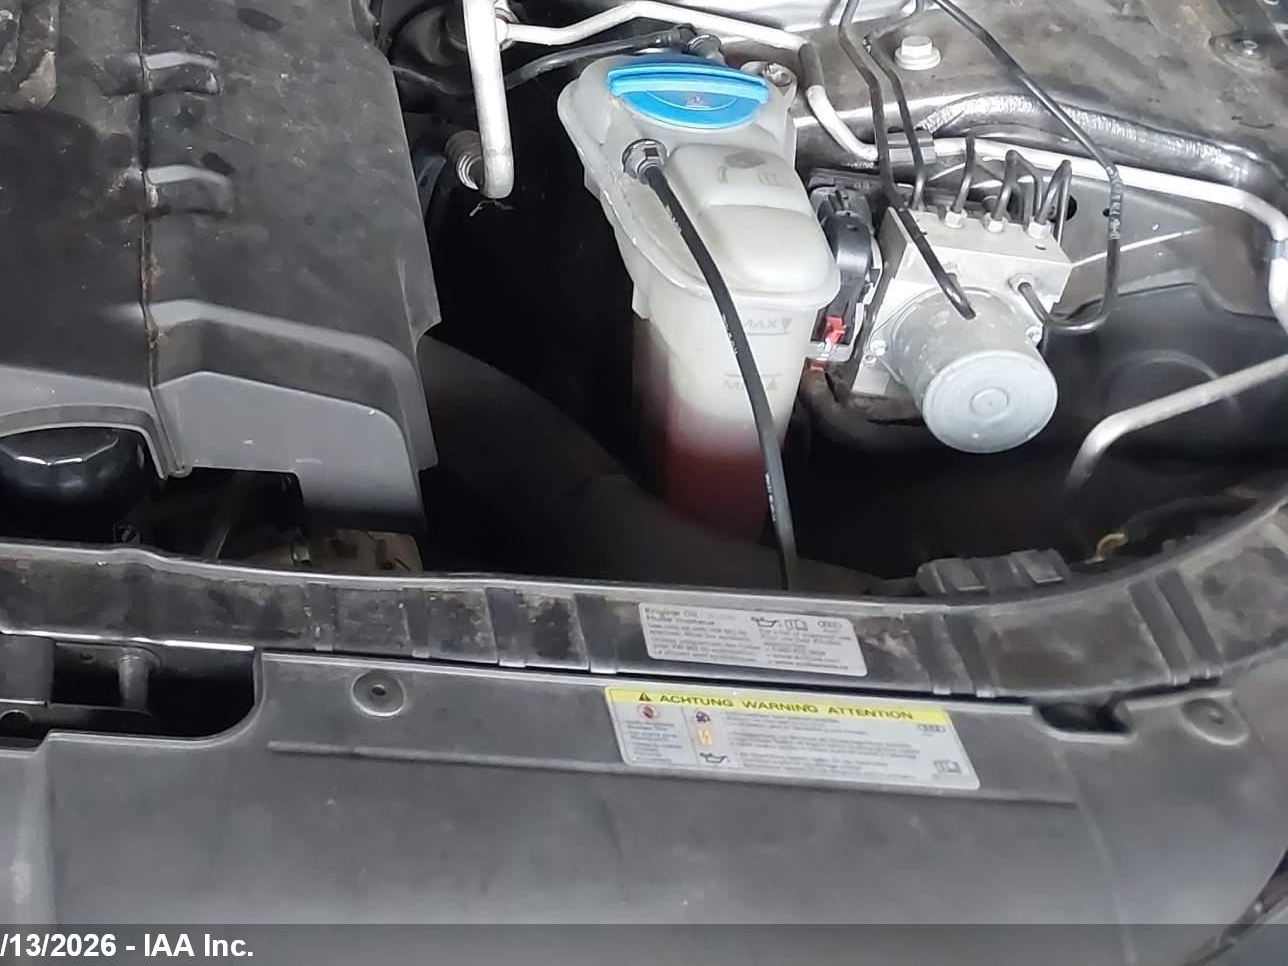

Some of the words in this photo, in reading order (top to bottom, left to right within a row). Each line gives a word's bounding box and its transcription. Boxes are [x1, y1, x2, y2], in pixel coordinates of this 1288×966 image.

[660, 695, 733, 707] ACHTUNG
[742, 701, 818, 713] WARNING
[828, 706, 914, 720] ATTENTION
